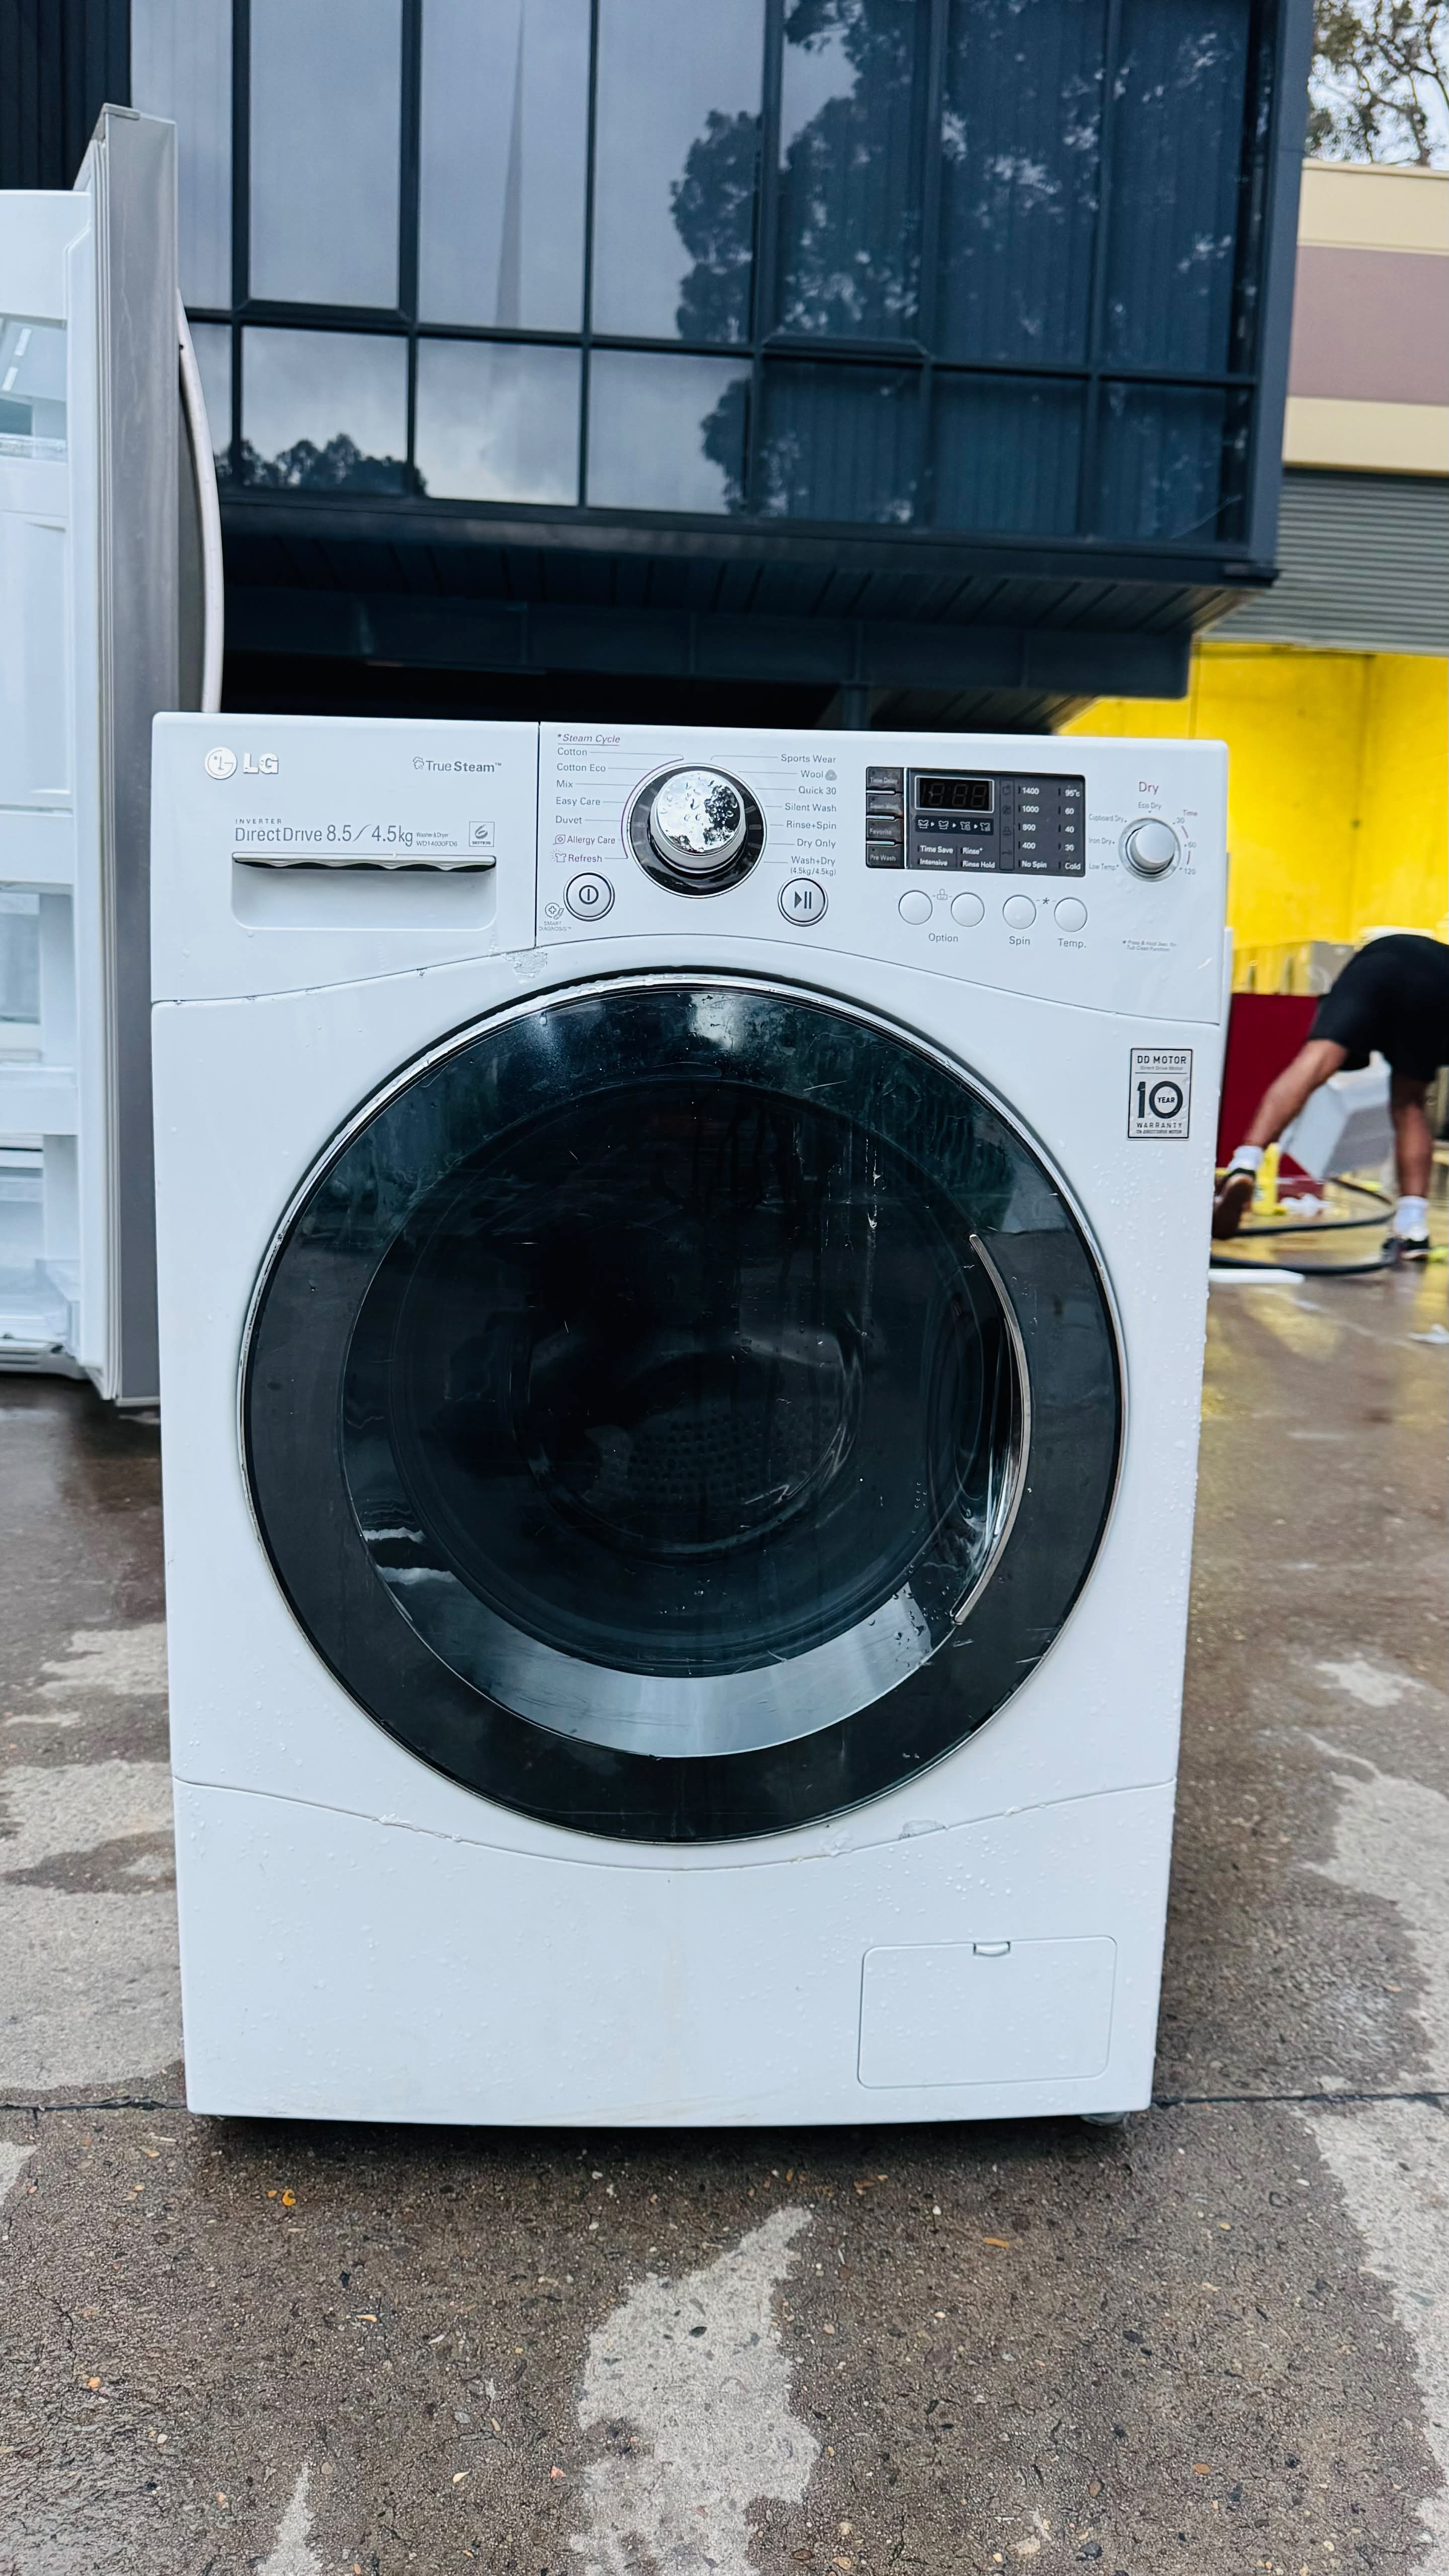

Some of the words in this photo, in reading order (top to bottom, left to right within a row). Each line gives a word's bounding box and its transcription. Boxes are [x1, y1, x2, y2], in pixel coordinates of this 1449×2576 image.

[596, 735, 620, 745] Cycle
[557, 748, 588, 756] Cotton
[244, 753, 279, 774] LG
[781, 754, 811, 763] Sports
[813, 754, 837, 763] Wear
[556, 763, 587, 771] Cotton
[590, 764, 606, 772] Eco
[800, 769, 824, 778] Wool
[556, 780, 573, 788] Mix
[1139, 781, 1159, 795] Dry
[798, 785, 824, 794] Quick
[826, 787, 837, 795] 30
[1022, 787, 1039, 795] 1400
[556, 796, 578, 807] Easy
[580, 797, 601, 806] Care
[1151, 802, 1162, 811] Dry
[785, 802, 810, 812] Silent
[812, 803, 837, 812] Wash
[555, 815, 582, 824] Duvet
[786, 820, 837, 831] Rinse+Spin
[567, 835, 595, 846] Allergy
[597, 836, 615, 844] Care
[797, 838, 813, 849] Dry
[815, 839, 836, 849] Only
[937, 846, 953, 854] Save
[568, 854, 603, 862] Refresh
[791, 855, 836, 866] Wash+Dry
[920, 858, 948, 866] Intensive
[1021, 860, 1031, 868] No
[1032, 861, 1048, 869] Spin
[928, 932, 958, 943] Option
[1009, 936, 1031, 946] Spin
[1058, 938, 1087, 948] Temp.
[1137, 1056, 1150, 1064] DD
[1153, 1056, 1187, 1064] MOTOR
[1137, 1081, 1183, 1119] 10
